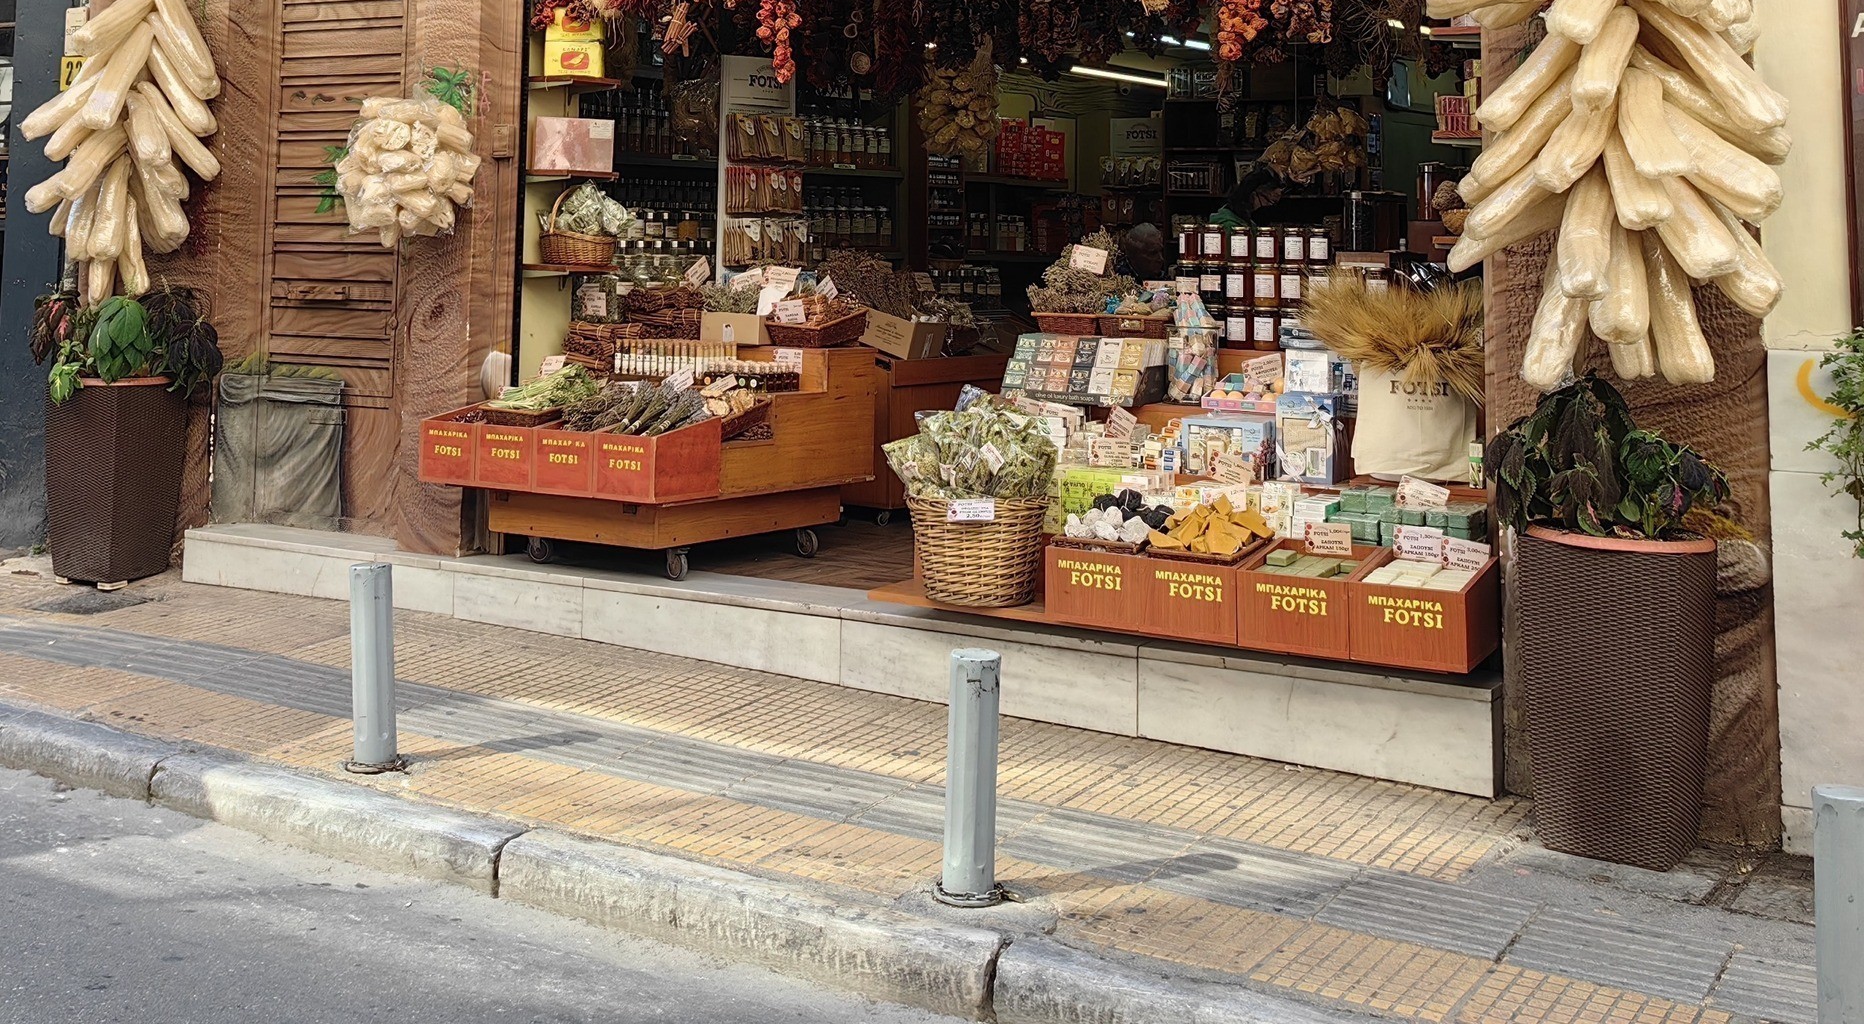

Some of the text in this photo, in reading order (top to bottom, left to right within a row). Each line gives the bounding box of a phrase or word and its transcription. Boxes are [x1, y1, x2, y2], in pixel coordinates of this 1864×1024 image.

[1125, 129, 1157, 140] FOTSI
[428, 429, 468, 439] ΜΠΑΧΑΡΙΚΑ
[485, 433, 524, 442] ΜΠΑΧΑΡΙΚΑ
[434, 444, 462, 457] FOTSI
[491, 447, 520, 460] FOTSI
[602, 443, 645, 454] ΜΠΑΧΑΡΙΚΑ
[549, 453, 578, 465] FOTSI
[609, 458, 641, 471] FOTSI
[1449, 547, 1466, 555] FOTSI
[1057, 559, 1122, 575] ΜΠΑΧΑΡΙΚΑ
[1070, 571, 1122, 591] FOTSI
[1155, 570, 1223, 586] ΜΠΑΧΑΡΙΚΑ
[1169, 582, 1223, 602] FOTSI
[1256, 582, 1327, 599] ΜΠΑΧΑΡΙΚΑ
[1271, 595, 1328, 616] FOTSI
[1368, 595, 1443, 612] ΜΠΑΧΑΡΙΚΑ
[1383, 608, 1443, 629] FOTSI
